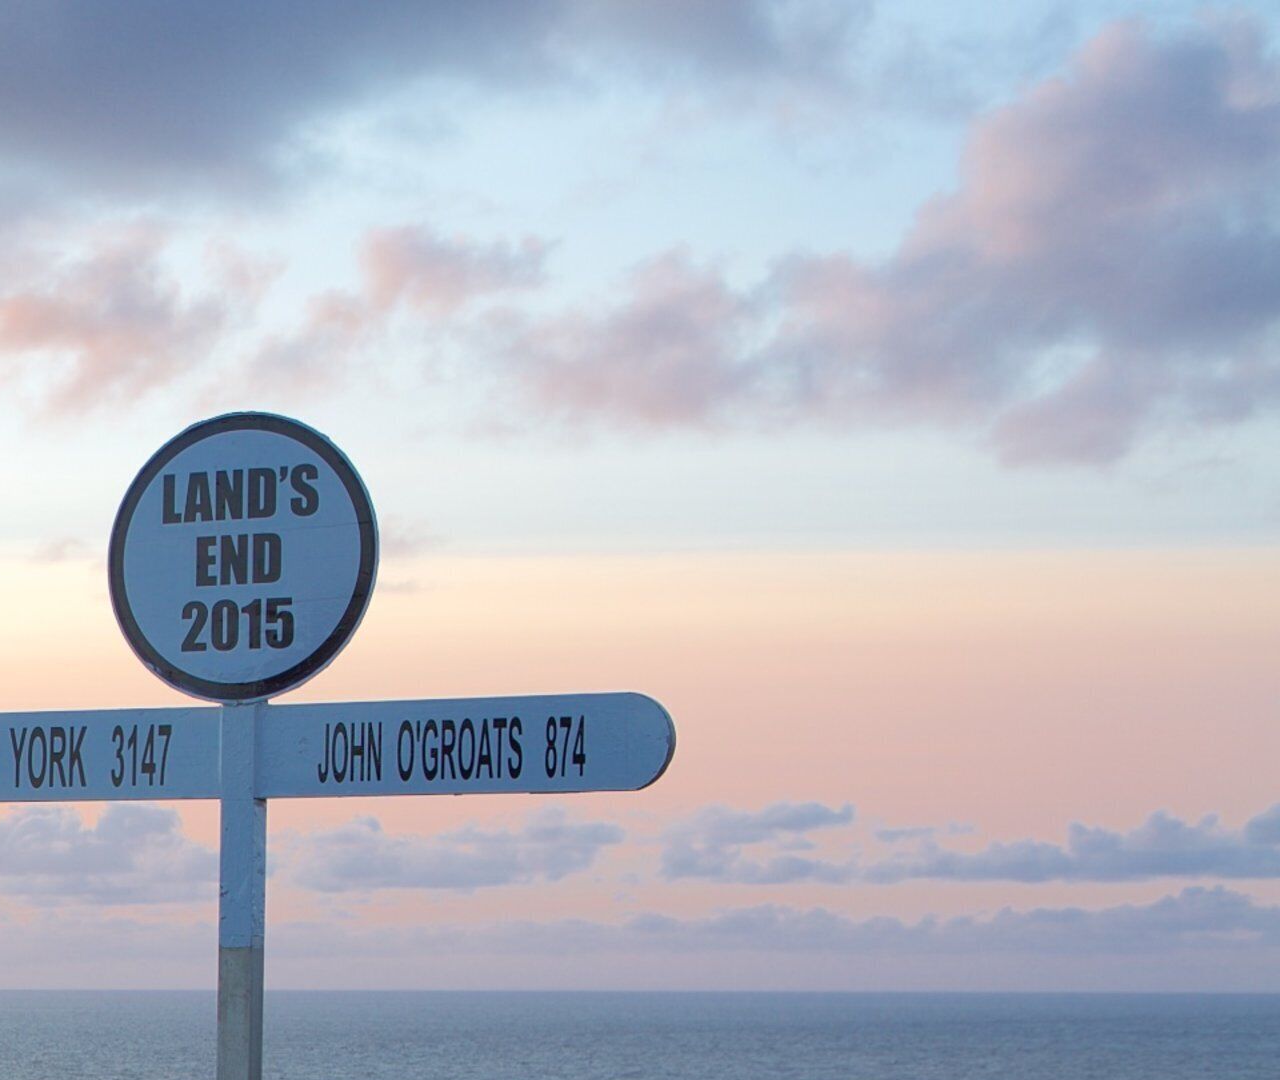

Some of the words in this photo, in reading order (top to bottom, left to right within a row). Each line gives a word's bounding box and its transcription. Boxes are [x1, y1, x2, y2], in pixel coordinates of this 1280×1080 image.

[161, 463, 320, 525] LAND'S
[195, 532, 282, 587] END
[180, 596, 295, 653] 2015
[9, 725, 88, 789] YORK
[110, 723, 173, 788] 3147
[317, 721, 383, 784] JOHN
[397, 716, 523, 782] O'GROATS
[544, 715, 586, 779] 874
